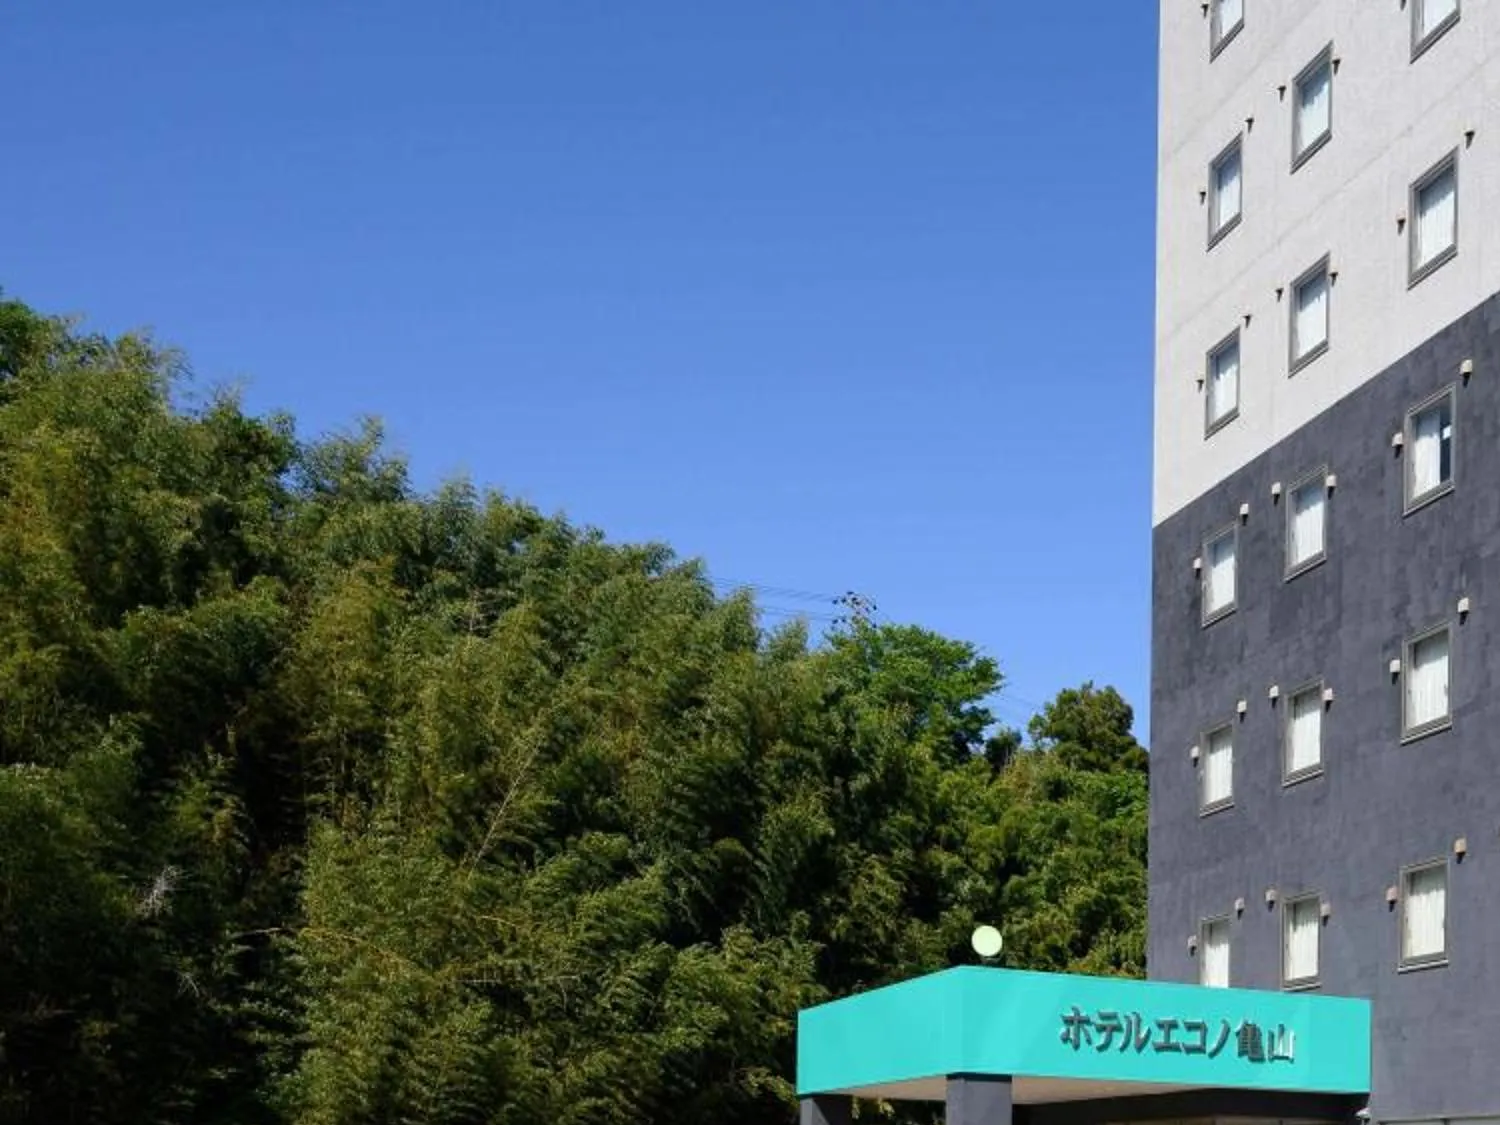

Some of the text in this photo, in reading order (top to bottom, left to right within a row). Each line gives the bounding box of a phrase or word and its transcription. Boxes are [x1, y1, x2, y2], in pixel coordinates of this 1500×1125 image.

[1060, 1006, 1296, 1064] ホテルエコノ亀山
